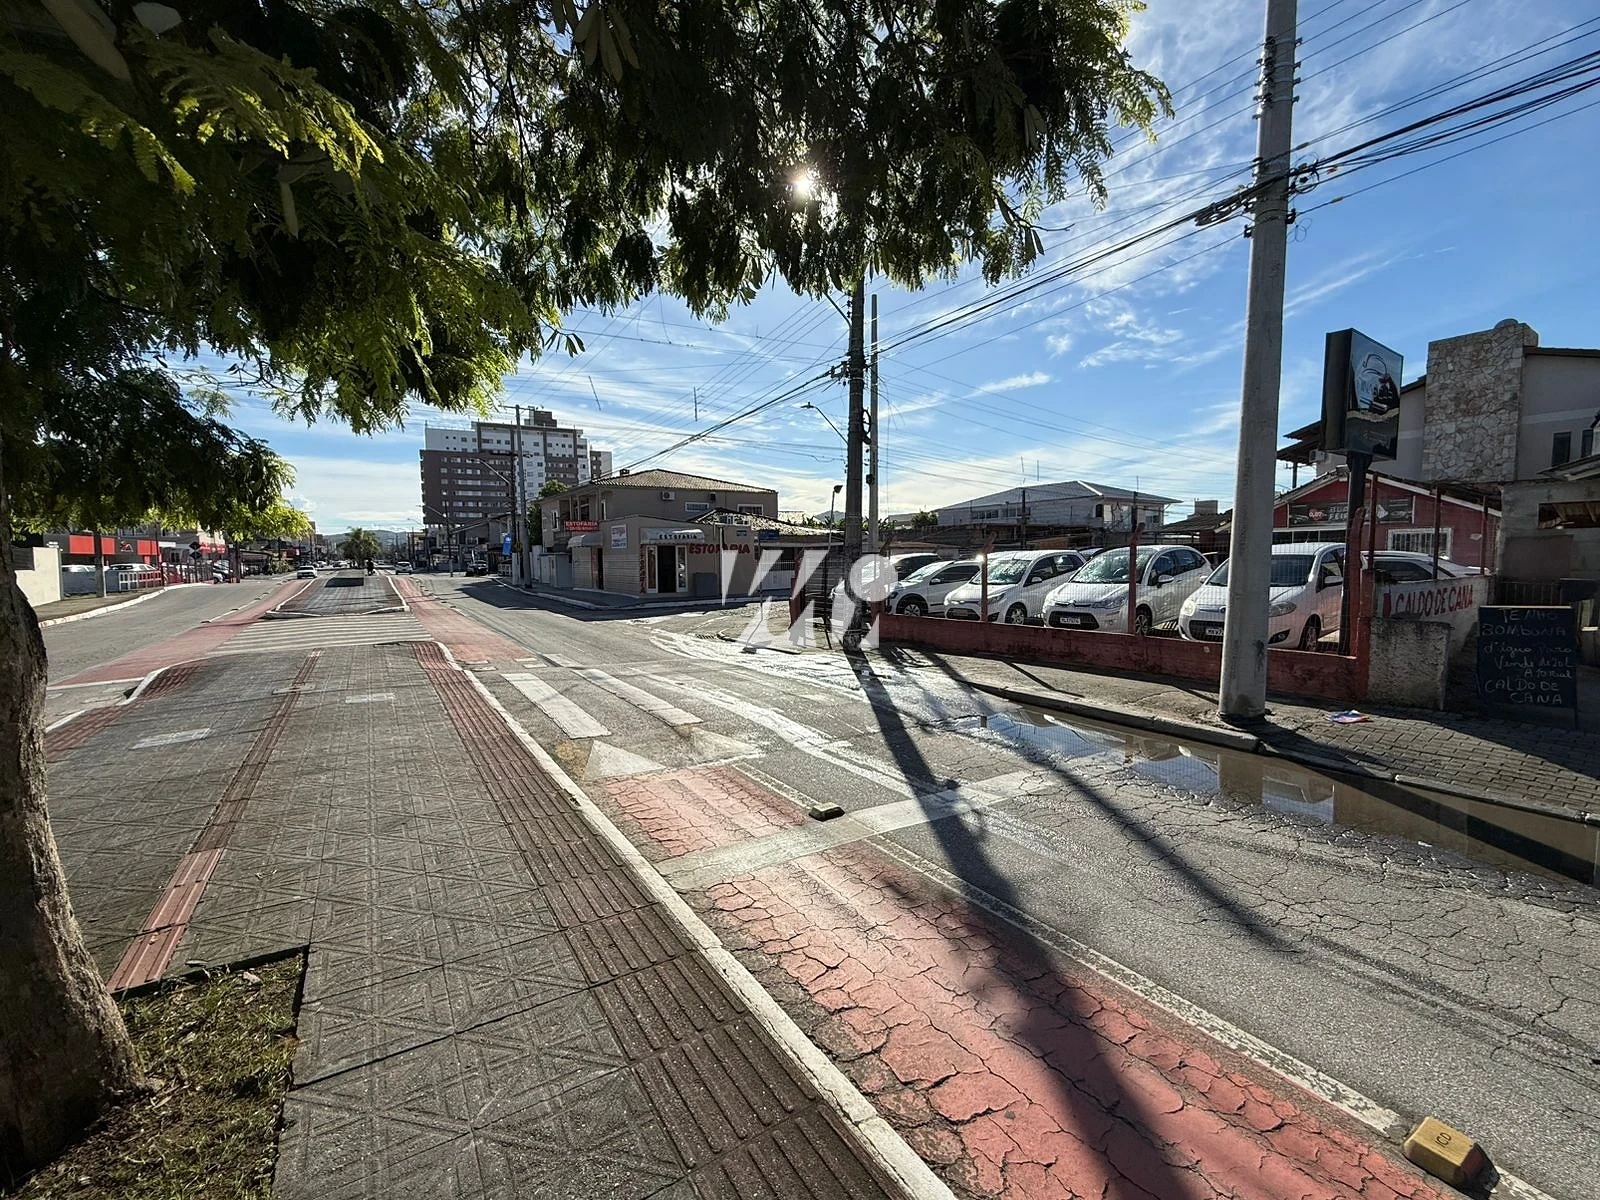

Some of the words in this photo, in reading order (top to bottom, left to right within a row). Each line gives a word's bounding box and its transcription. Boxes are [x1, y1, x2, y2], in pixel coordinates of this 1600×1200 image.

[1396, 590, 1433, 617] CALDO
[1434, 588, 1448, 615] DE
[1448, 584, 1473, 612] CANA
[1485, 676, 1537, 693] CALDO
[1540, 680, 1560, 691] DE
[1510, 692, 1562, 704] CANA
